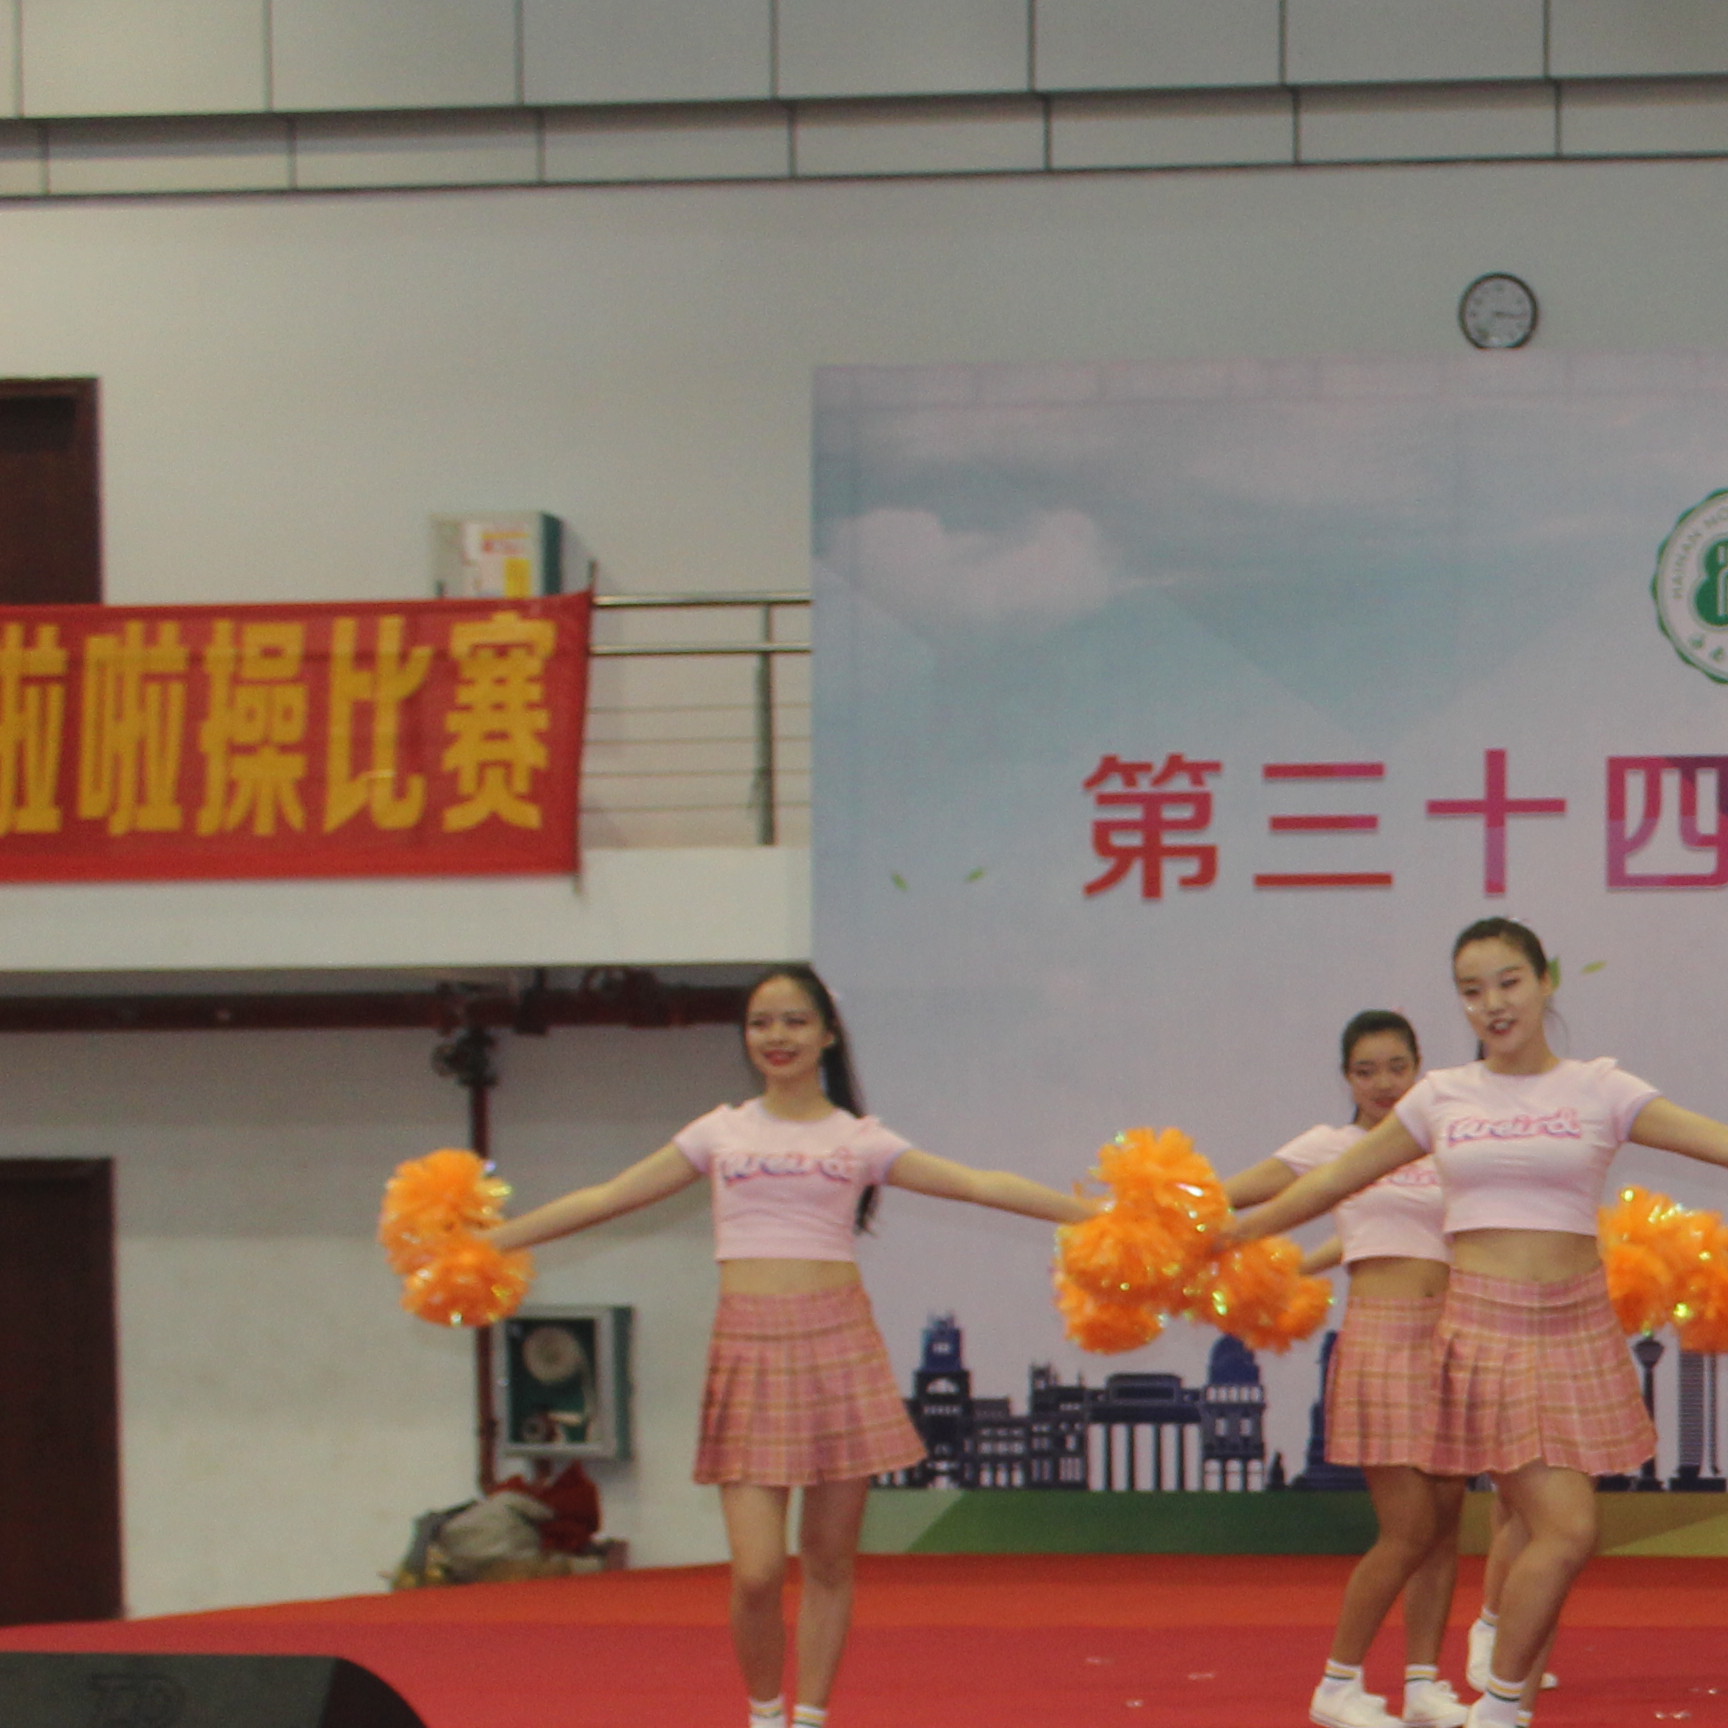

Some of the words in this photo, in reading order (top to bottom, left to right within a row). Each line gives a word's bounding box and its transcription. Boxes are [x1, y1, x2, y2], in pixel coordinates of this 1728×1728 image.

[0, 611, 558, 838] 啦啦操比赛
